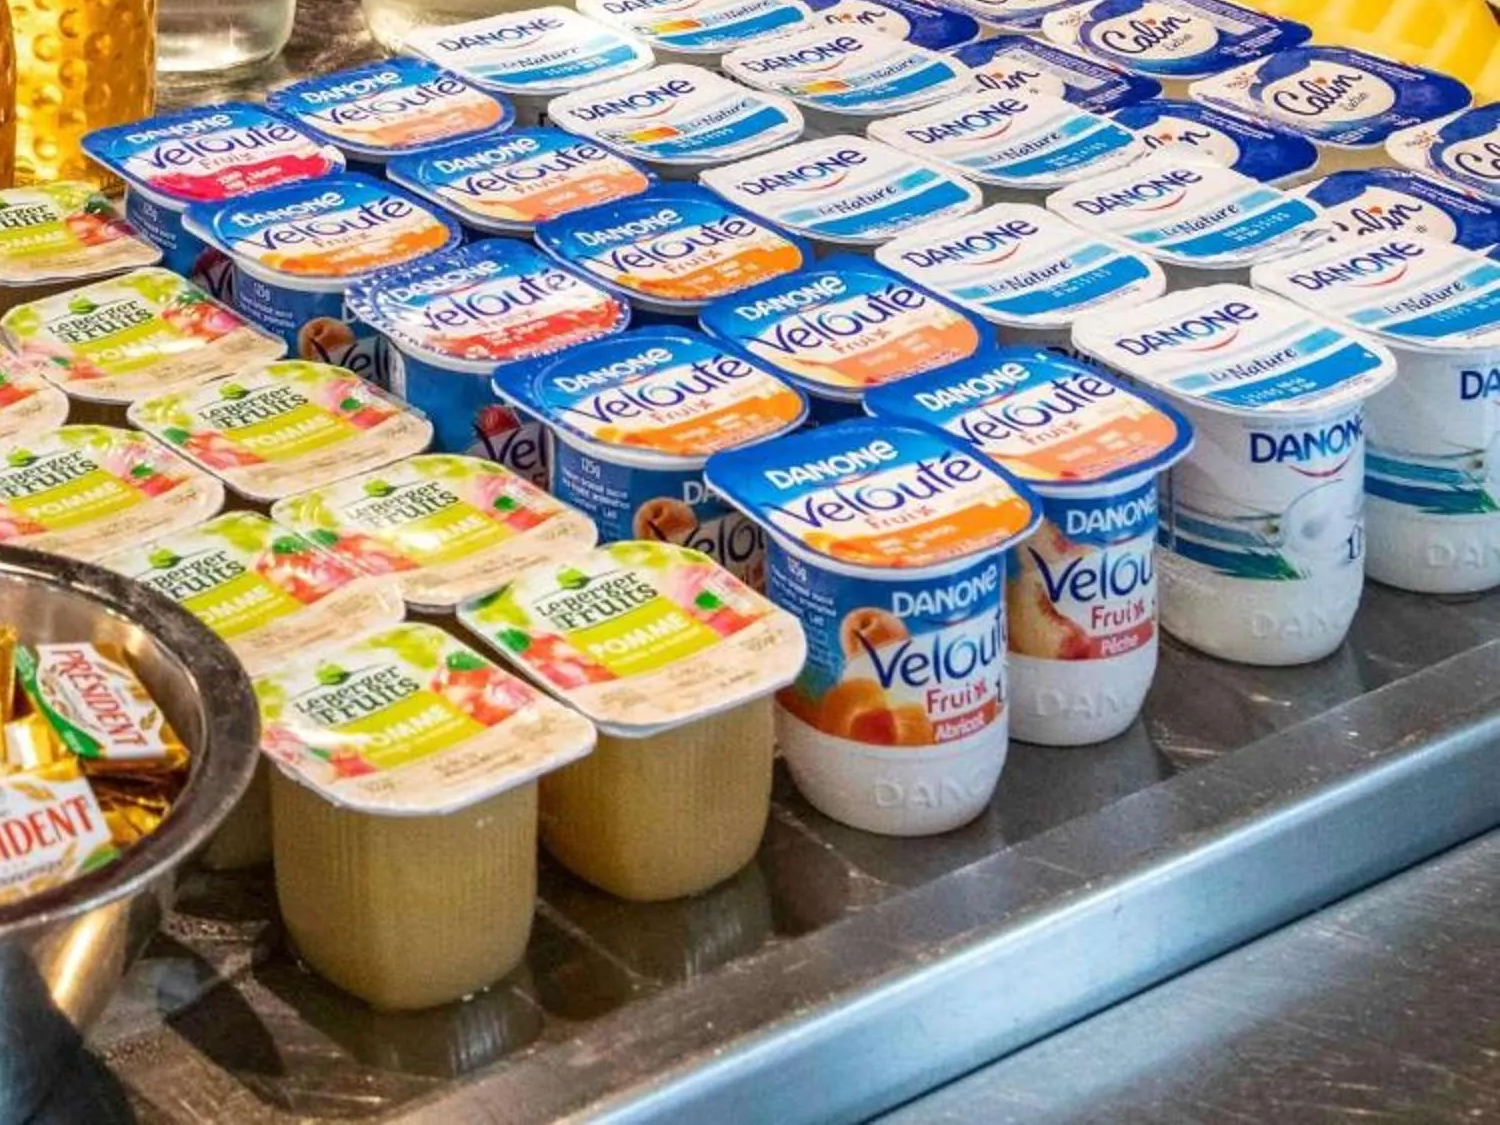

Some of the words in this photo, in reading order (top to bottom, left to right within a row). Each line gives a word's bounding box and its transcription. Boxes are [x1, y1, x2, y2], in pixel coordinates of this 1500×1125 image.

[436, 15, 566, 52] DANONE
[742, 35, 865, 74] DANONE
[301, 71, 403, 104] DANONE
[309, 72, 467, 125] Velouté
[568, 78, 697, 123] DANONE
[126, 113, 234, 146] DANONE
[905, 95, 1030, 146] DANONE
[134, 121, 298, 170] Velouté
[433, 137, 541, 174] DANONE
[452, 142, 609, 197] Velouté
[736, 148, 868, 197] DANONE
[1071, 167, 1204, 216] DANONE
[230, 191, 345, 228] DANONE
[244, 196, 414, 251] Velouté
[832, 185, 899, 214] Nature
[1174, 200, 1240, 235] Nature
[574, 208, 684, 247] DANONE
[580, 215, 757, 274] Velouté
[900, 217, 1040, 269] DANONE
[1002, 256, 1074, 293] Nature
[1287, 240, 1426, 291] DANONE
[734, 275, 848, 322] DANONE
[742, 283, 926, 355] Velouté
[1400, 278, 1468, 314] Nature
[828, 328, 891, 355] Fruix
[1113, 300, 1260, 358] DANONE
[553, 347, 674, 394] DANONE
[914, 361, 1032, 412] DANONE
[1224, 344, 1298, 382] Nature
[558, 354, 752, 425] Velouté
[960, 373, 1116, 447] Velouté
[758, 450, 983, 528] Velouté
[763, 439, 900, 490] DANONE
[863, 504, 936, 530] Fruix
[560, 581, 660, 629] Fruits
[890, 563, 998, 617] DANONE
[1090, 596, 1146, 630] Fruix
[586, 611, 692, 660] POMME
[50, 648, 150, 747] PRÉSIDENT
[316, 676, 422, 725] Fruits
[925, 678, 988, 715] Fruix
